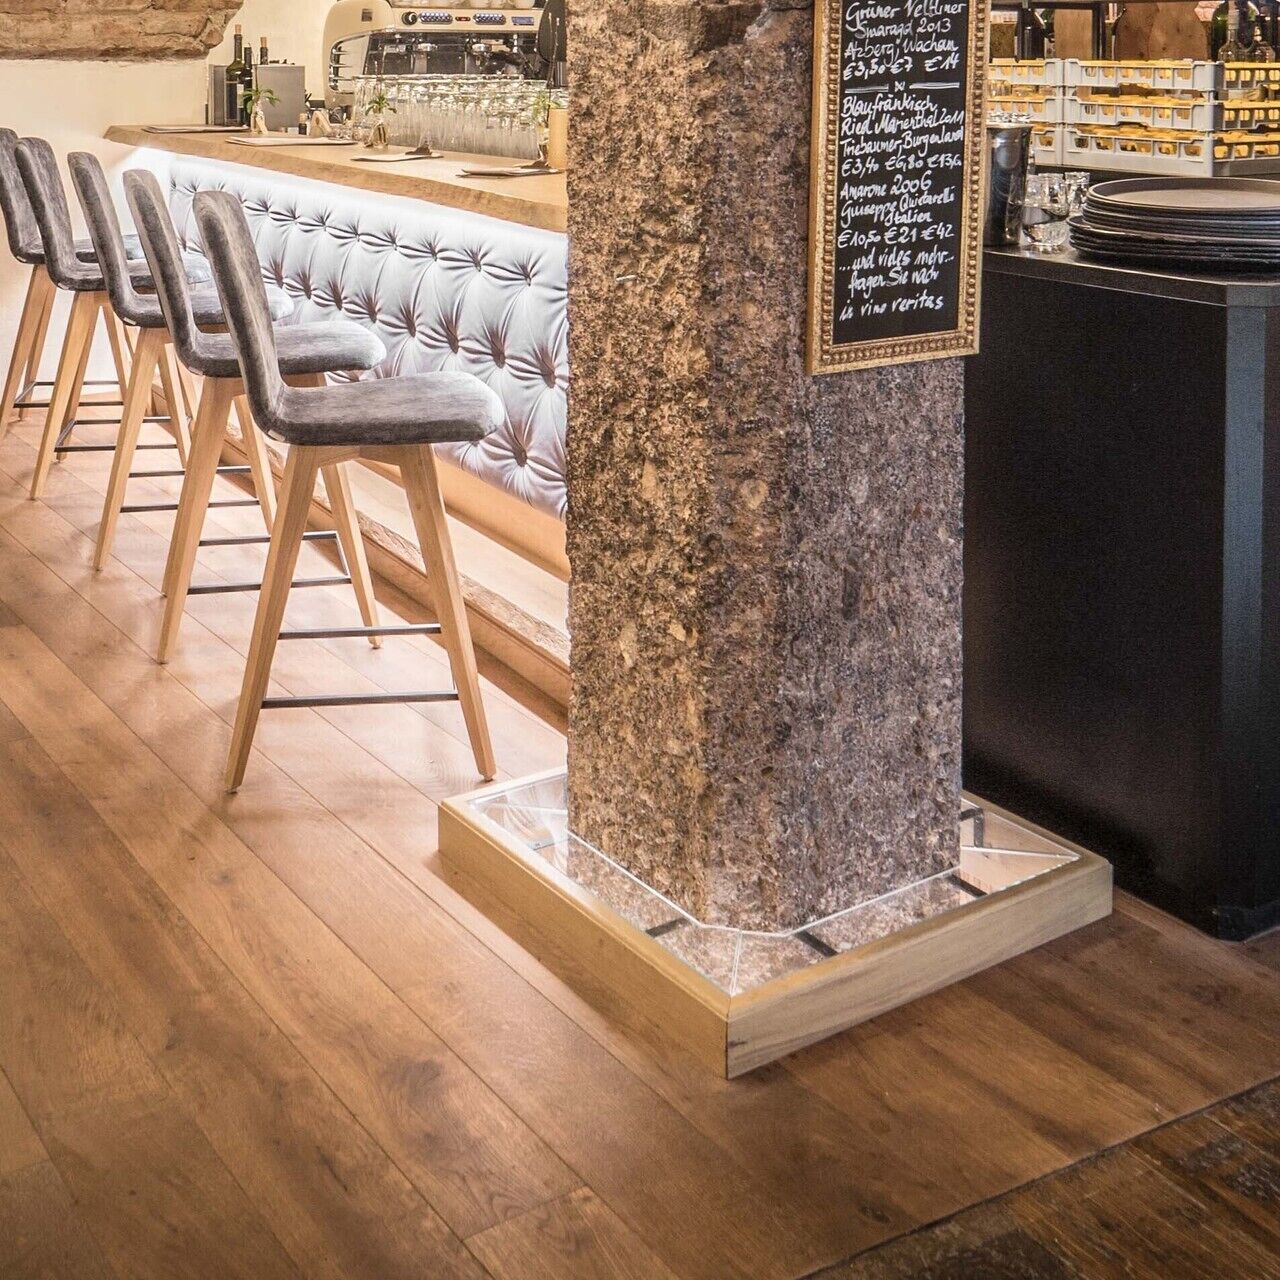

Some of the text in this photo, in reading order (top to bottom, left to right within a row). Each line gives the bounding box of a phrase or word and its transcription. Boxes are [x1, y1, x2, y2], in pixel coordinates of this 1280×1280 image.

[845, 0, 901, 31] Grüner
[854, 17, 952, 42] Smaragd 2013
[842, 58, 886, 81] €3,50
[840, 92, 938, 120] Blaufränkisch
[840, 108, 965, 136] Ried Marienthal 2011
[901, 125, 964, 157] Burgenland
[839, 170, 933, 200] Amarone 2006
[884, 226, 918, 244] €21
[921, 222, 955, 240] €42
[886, 266, 908, 287] Sie
[860, 299, 888, 317] vino
[891, 289, 944, 312] veritas
